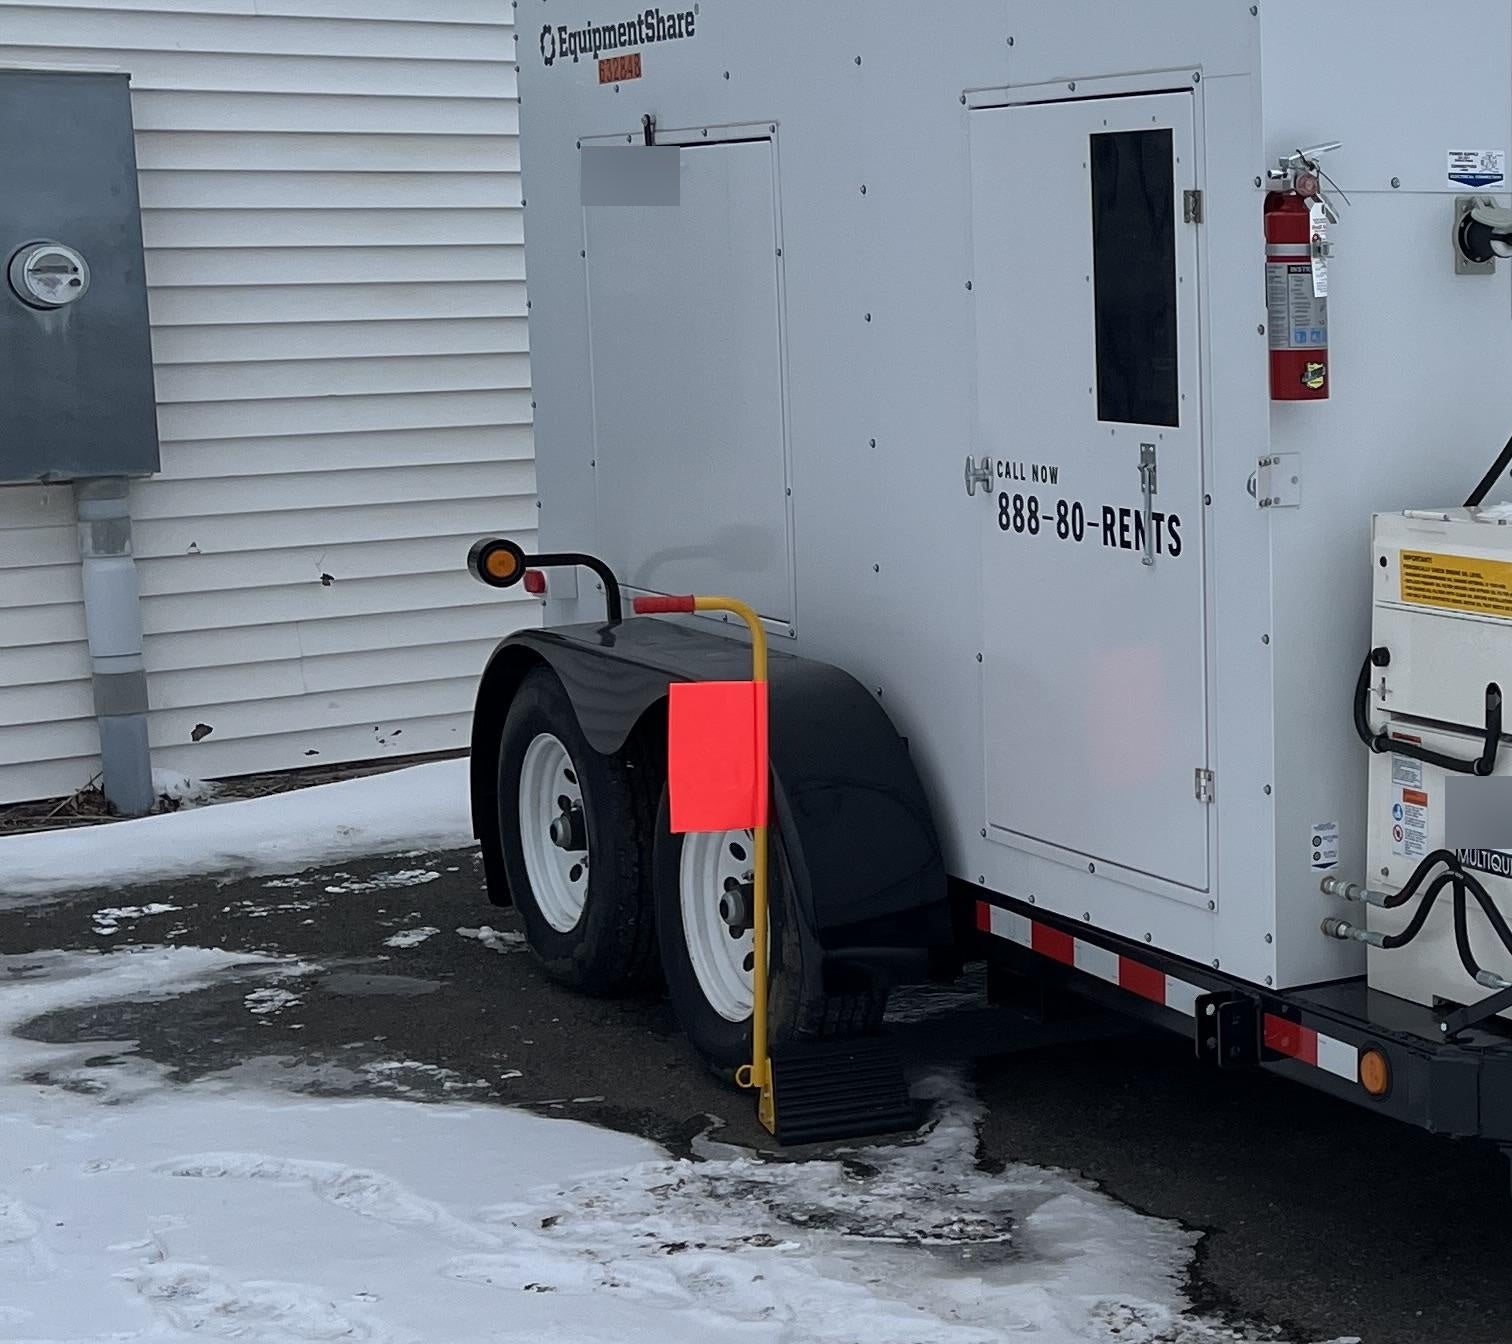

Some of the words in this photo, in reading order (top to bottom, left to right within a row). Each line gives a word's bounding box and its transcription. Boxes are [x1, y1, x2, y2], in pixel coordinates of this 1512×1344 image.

[557, 8, 695, 63] EquipmentShare
[996, 460, 1026, 481] CALL
[1032, 464, 1059, 484] NOW
[998, 492, 1182, 557] 888-80-RENTS
